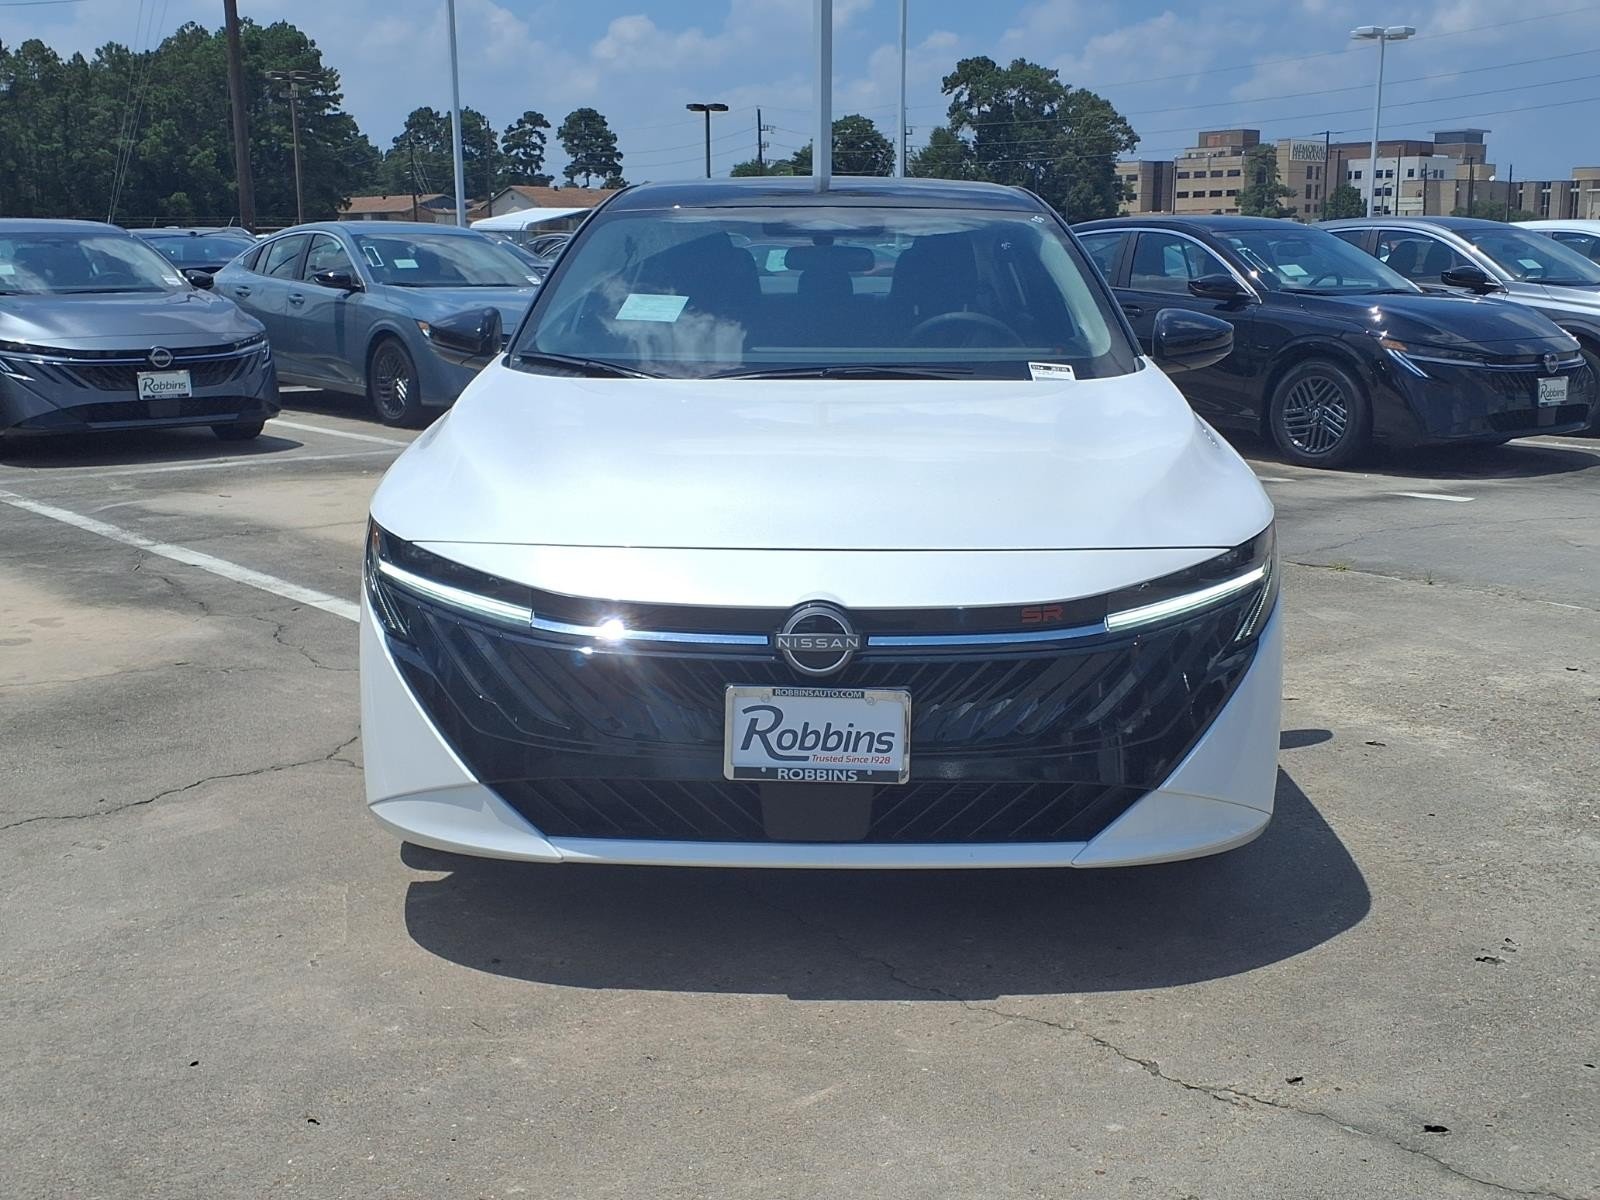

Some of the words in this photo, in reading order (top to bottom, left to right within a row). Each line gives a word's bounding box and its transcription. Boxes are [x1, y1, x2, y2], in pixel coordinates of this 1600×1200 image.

[142, 377, 186, 393] Robbins
[1021, 605, 1063, 623] SR
[778, 637, 859, 648] NISSAN
[775, 688, 862, 699] ROBBINSAUTO.COM
[740, 704, 895, 762] Robbins
[812, 754, 844, 763] Trusted
[846, 755, 869, 764] Since
[871, 756, 891, 765] 1928
[777, 768, 858, 782] ROBBINS
